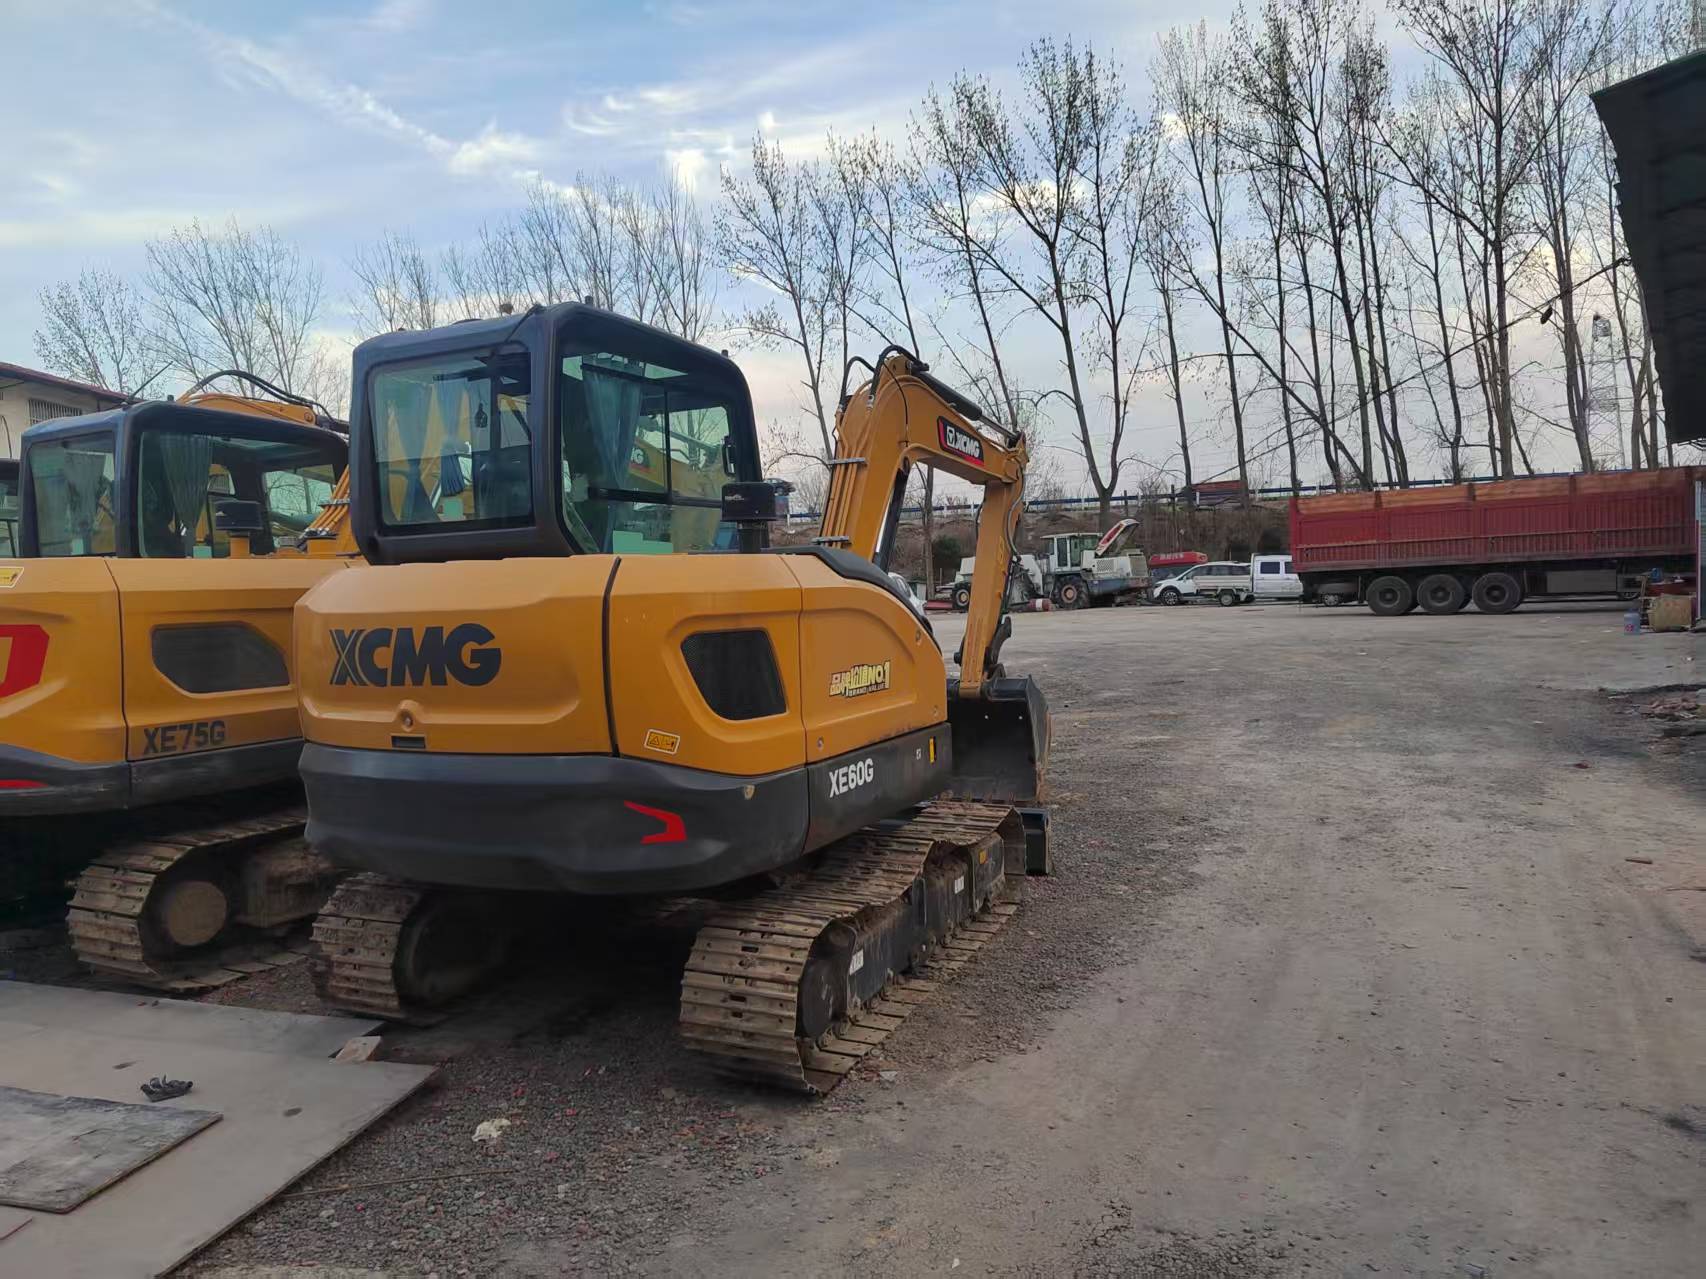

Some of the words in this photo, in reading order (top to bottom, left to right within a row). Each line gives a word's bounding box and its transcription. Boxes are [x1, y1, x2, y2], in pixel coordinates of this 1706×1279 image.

[955, 432, 980, 458] XCMG
[329, 623, 502, 687] XCMG
[143, 720, 226, 753] XE75G
[829, 758, 874, 798] XE60G
